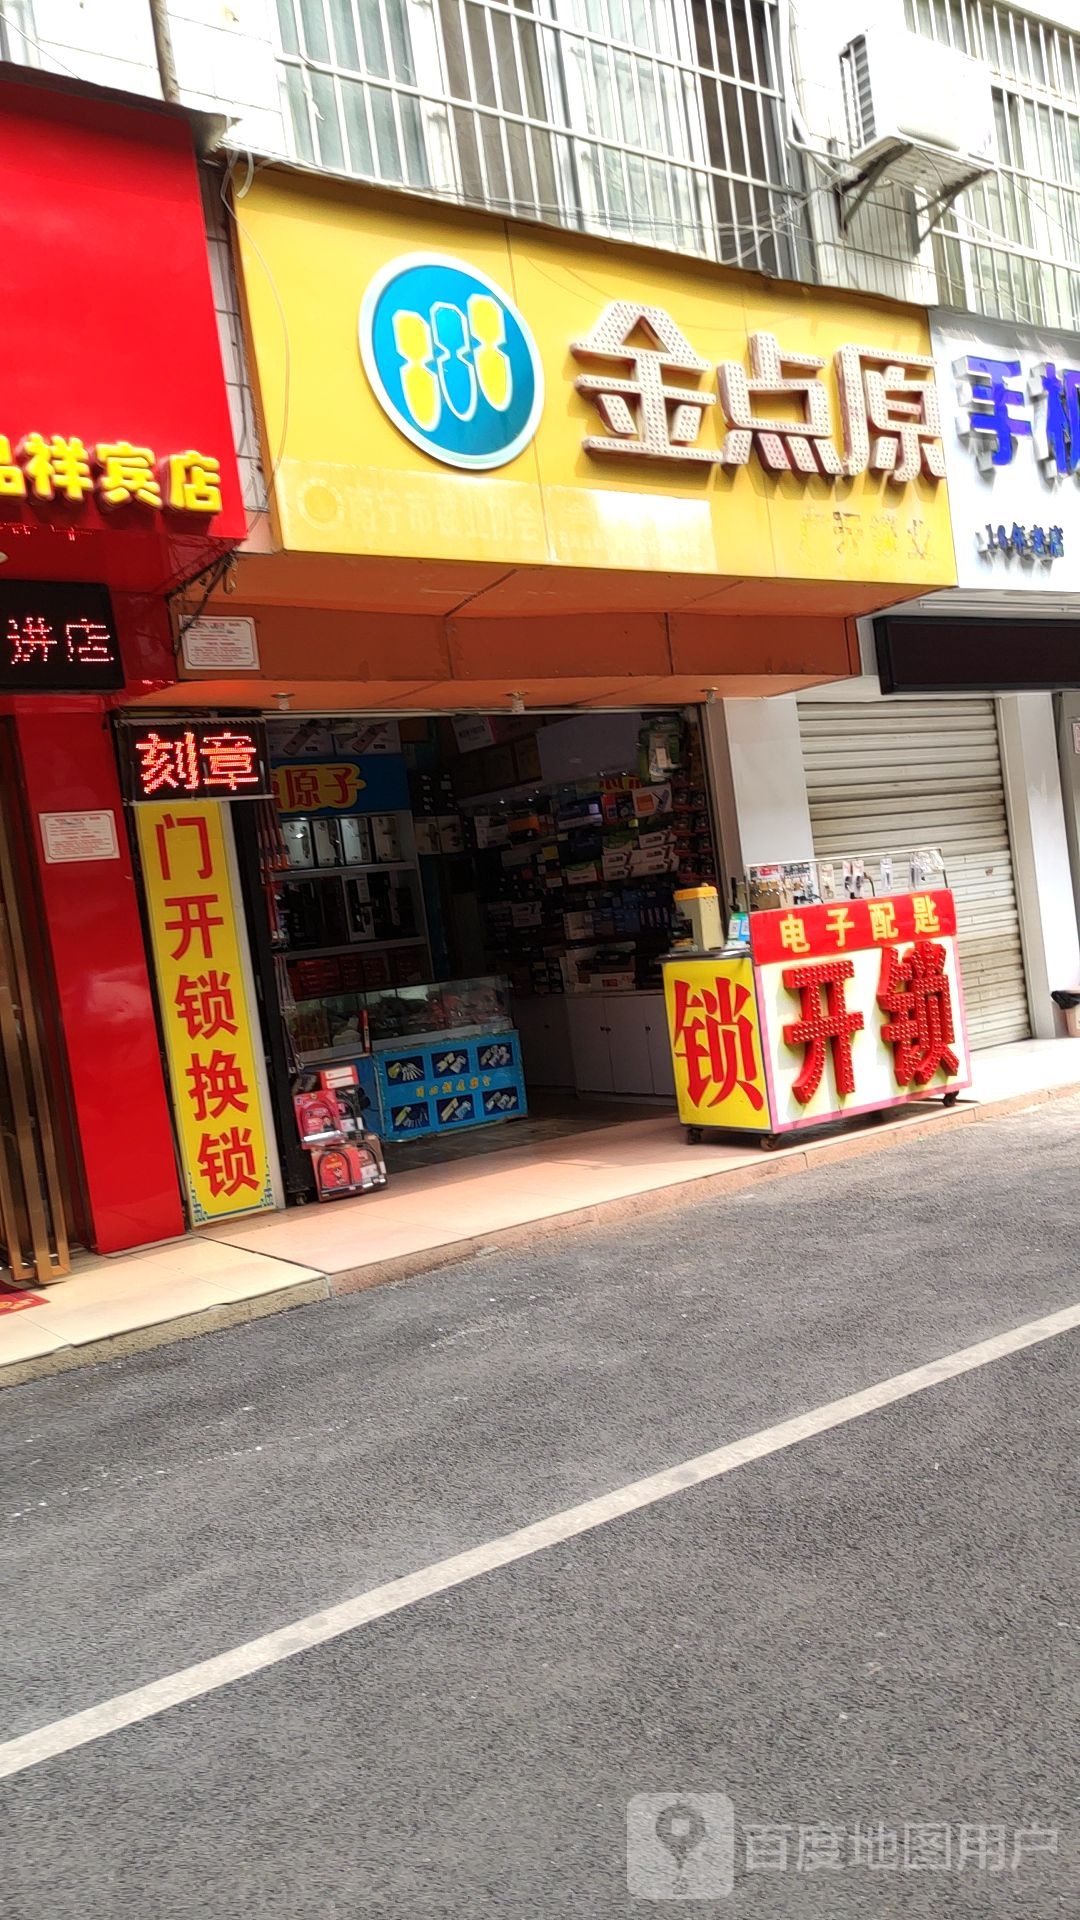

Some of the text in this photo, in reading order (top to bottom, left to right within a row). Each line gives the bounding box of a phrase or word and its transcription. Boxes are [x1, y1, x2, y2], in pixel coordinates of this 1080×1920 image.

[568, 300, 947, 483] 金点原
[135, 731, 259, 795] 刻章
[271, 766, 358, 809] 原子
[779, 895, 940, 954] 电子配匙
[154, 813, 261, 1199] 门开锁换锁
[673, 976, 764, 1112] 锁
[782, 940, 960, 1105] 开锁
